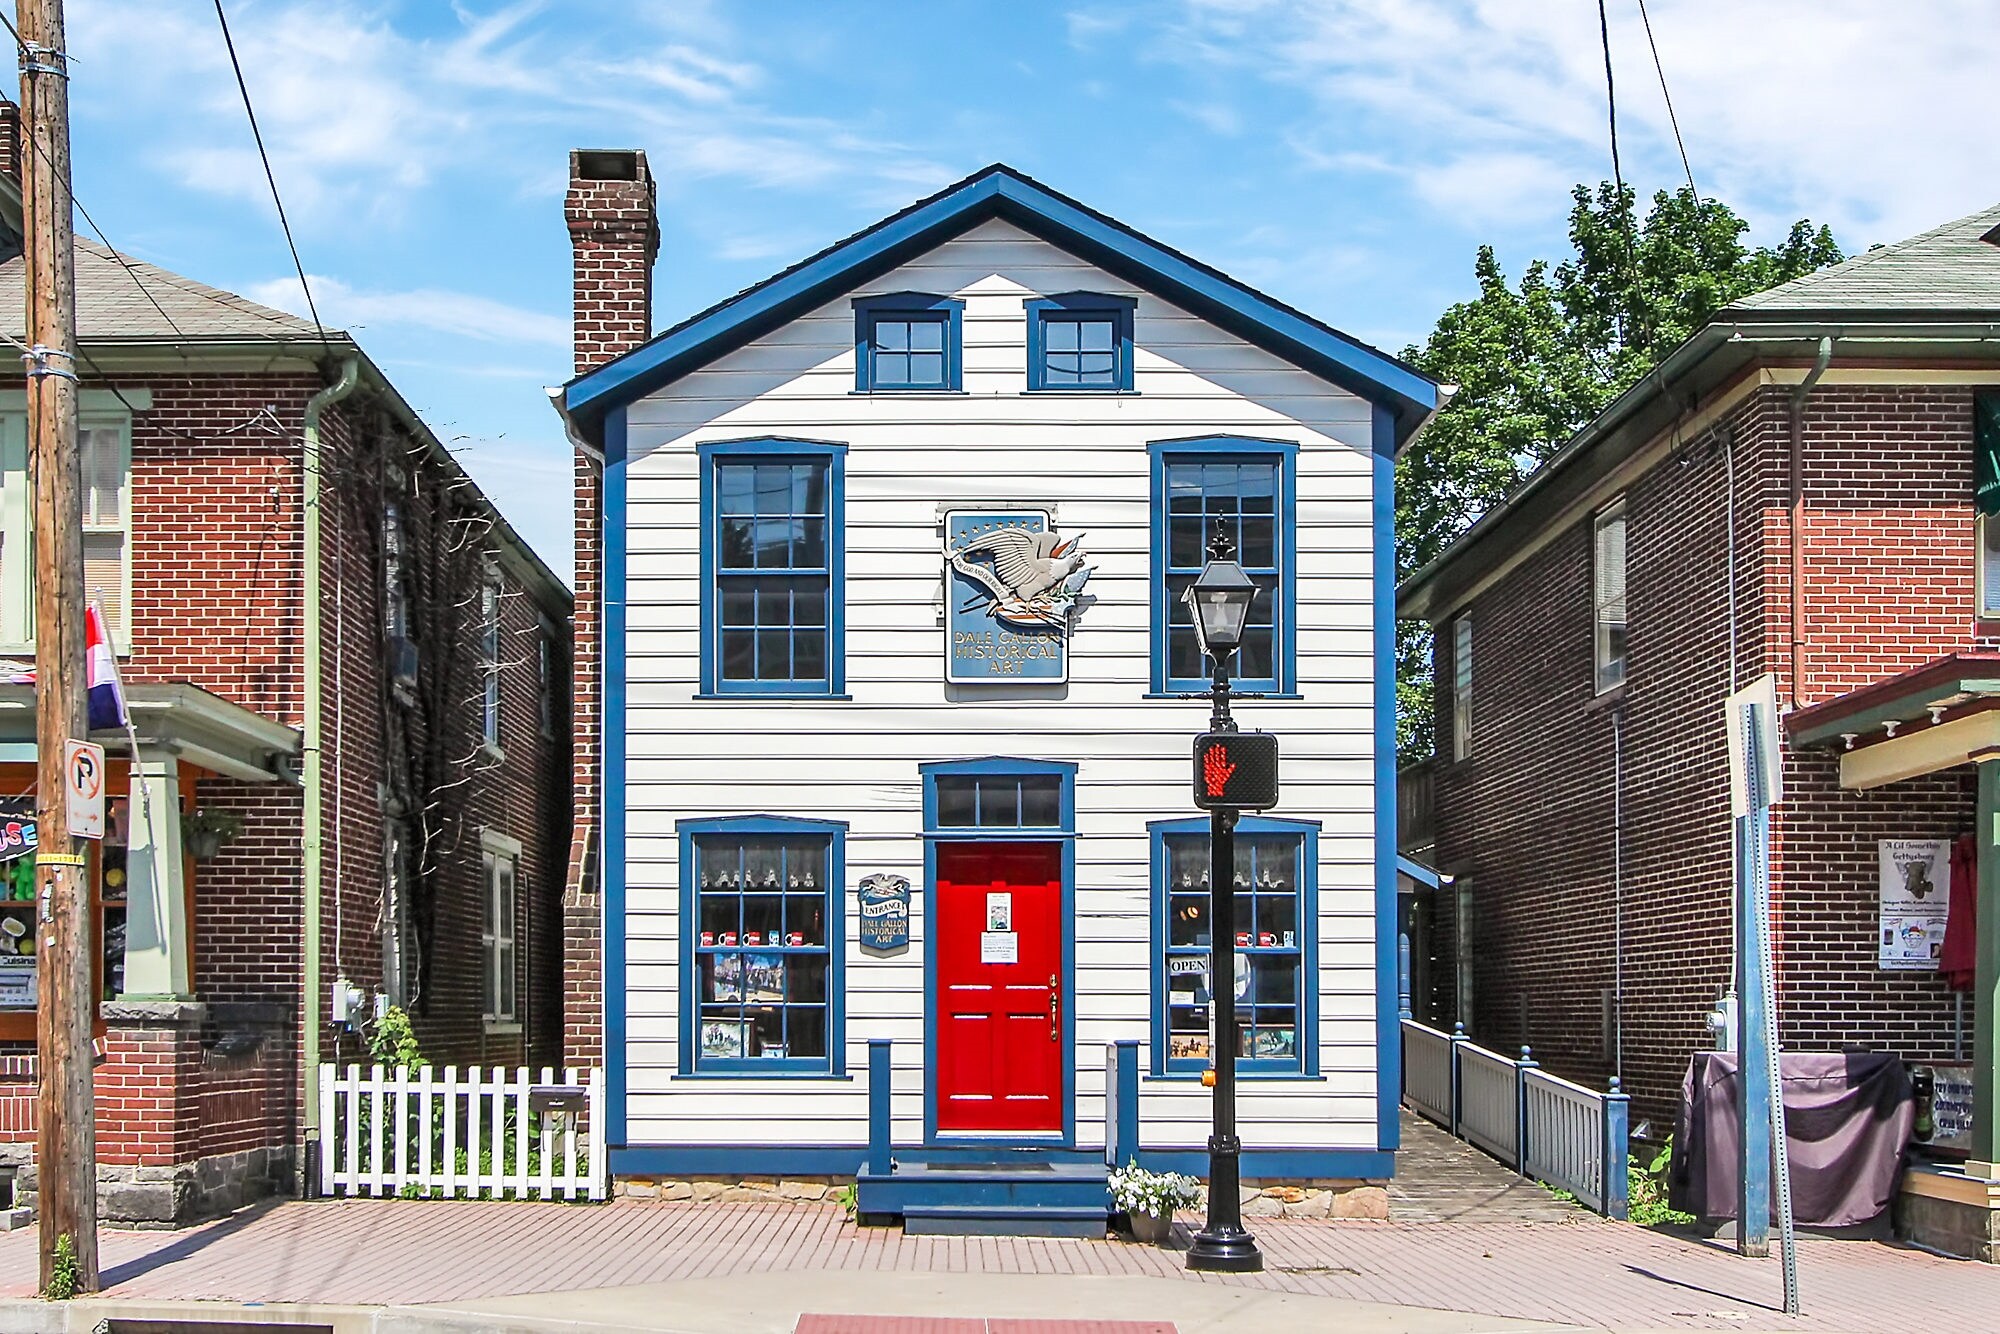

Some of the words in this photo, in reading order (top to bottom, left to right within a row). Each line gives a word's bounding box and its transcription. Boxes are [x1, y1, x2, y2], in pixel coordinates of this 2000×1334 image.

[954, 631, 992, 644] DALE
[998, 631, 1060, 644] GALLON
[955, 644, 1058, 659] HISTORICAL
[988, 660, 1024, 674] ART
[865, 902, 901, 914] ENTRANCE
[881, 919, 907, 928] GALLON
[862, 927, 906, 936] HISTORICAL
[875, 935, 893, 944] ART
[1171, 960, 1206, 971] OPEN
